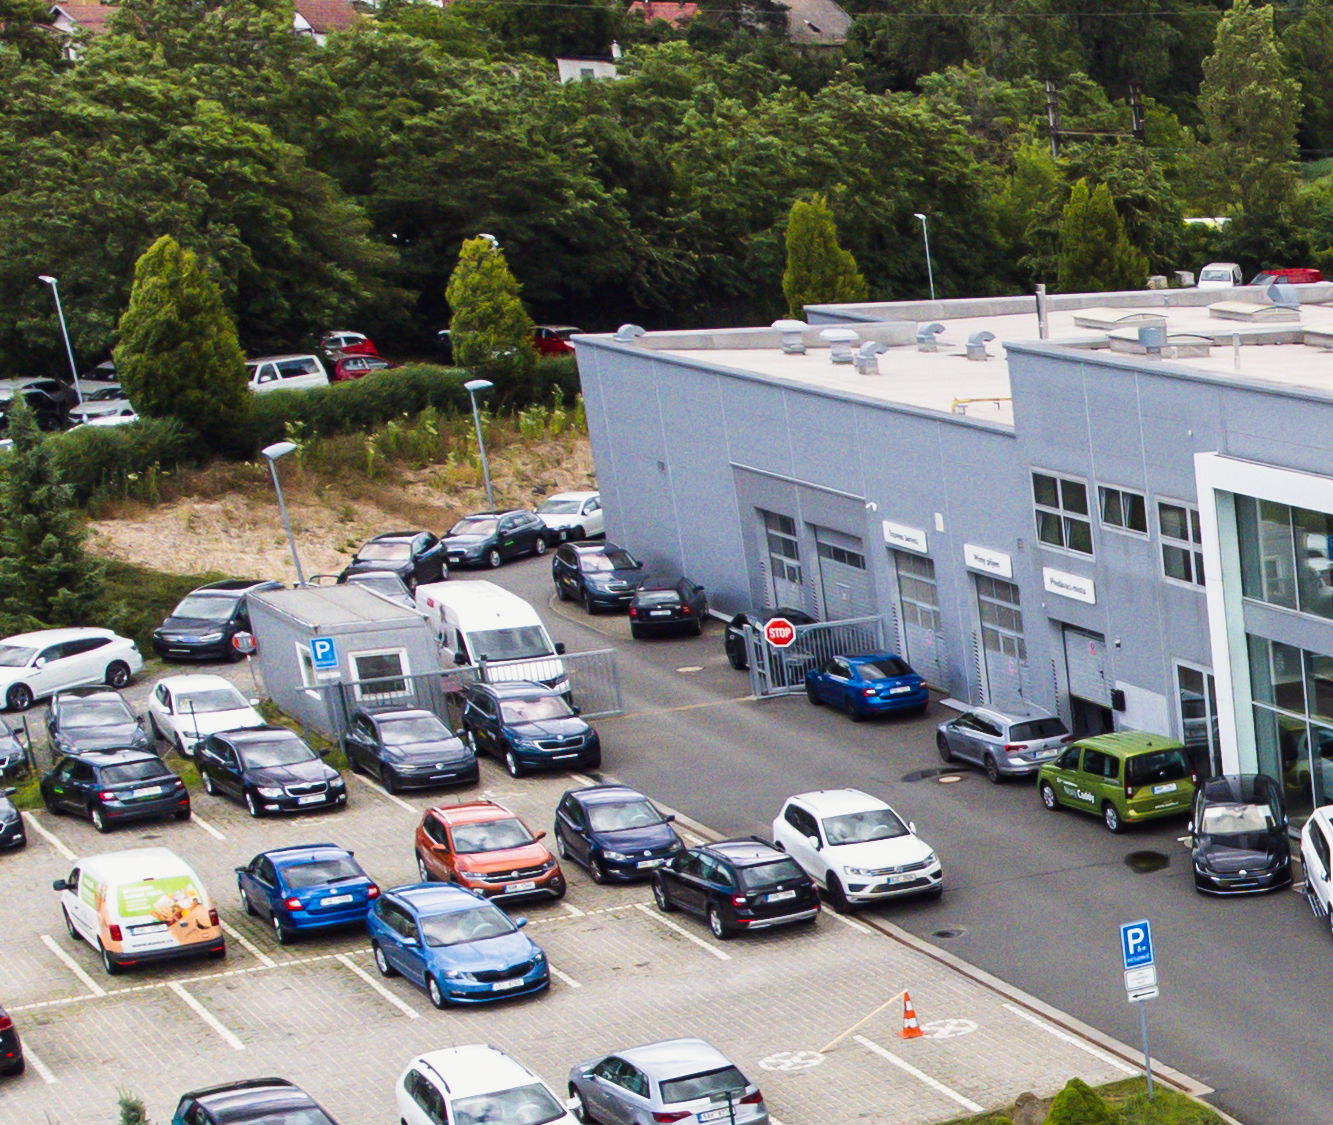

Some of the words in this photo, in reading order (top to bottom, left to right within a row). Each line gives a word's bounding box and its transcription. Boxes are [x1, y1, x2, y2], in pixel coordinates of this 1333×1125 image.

[768, 627, 792, 639] STOP
[315, 640, 331, 660] P
[1127, 927, 1145, 955] P
